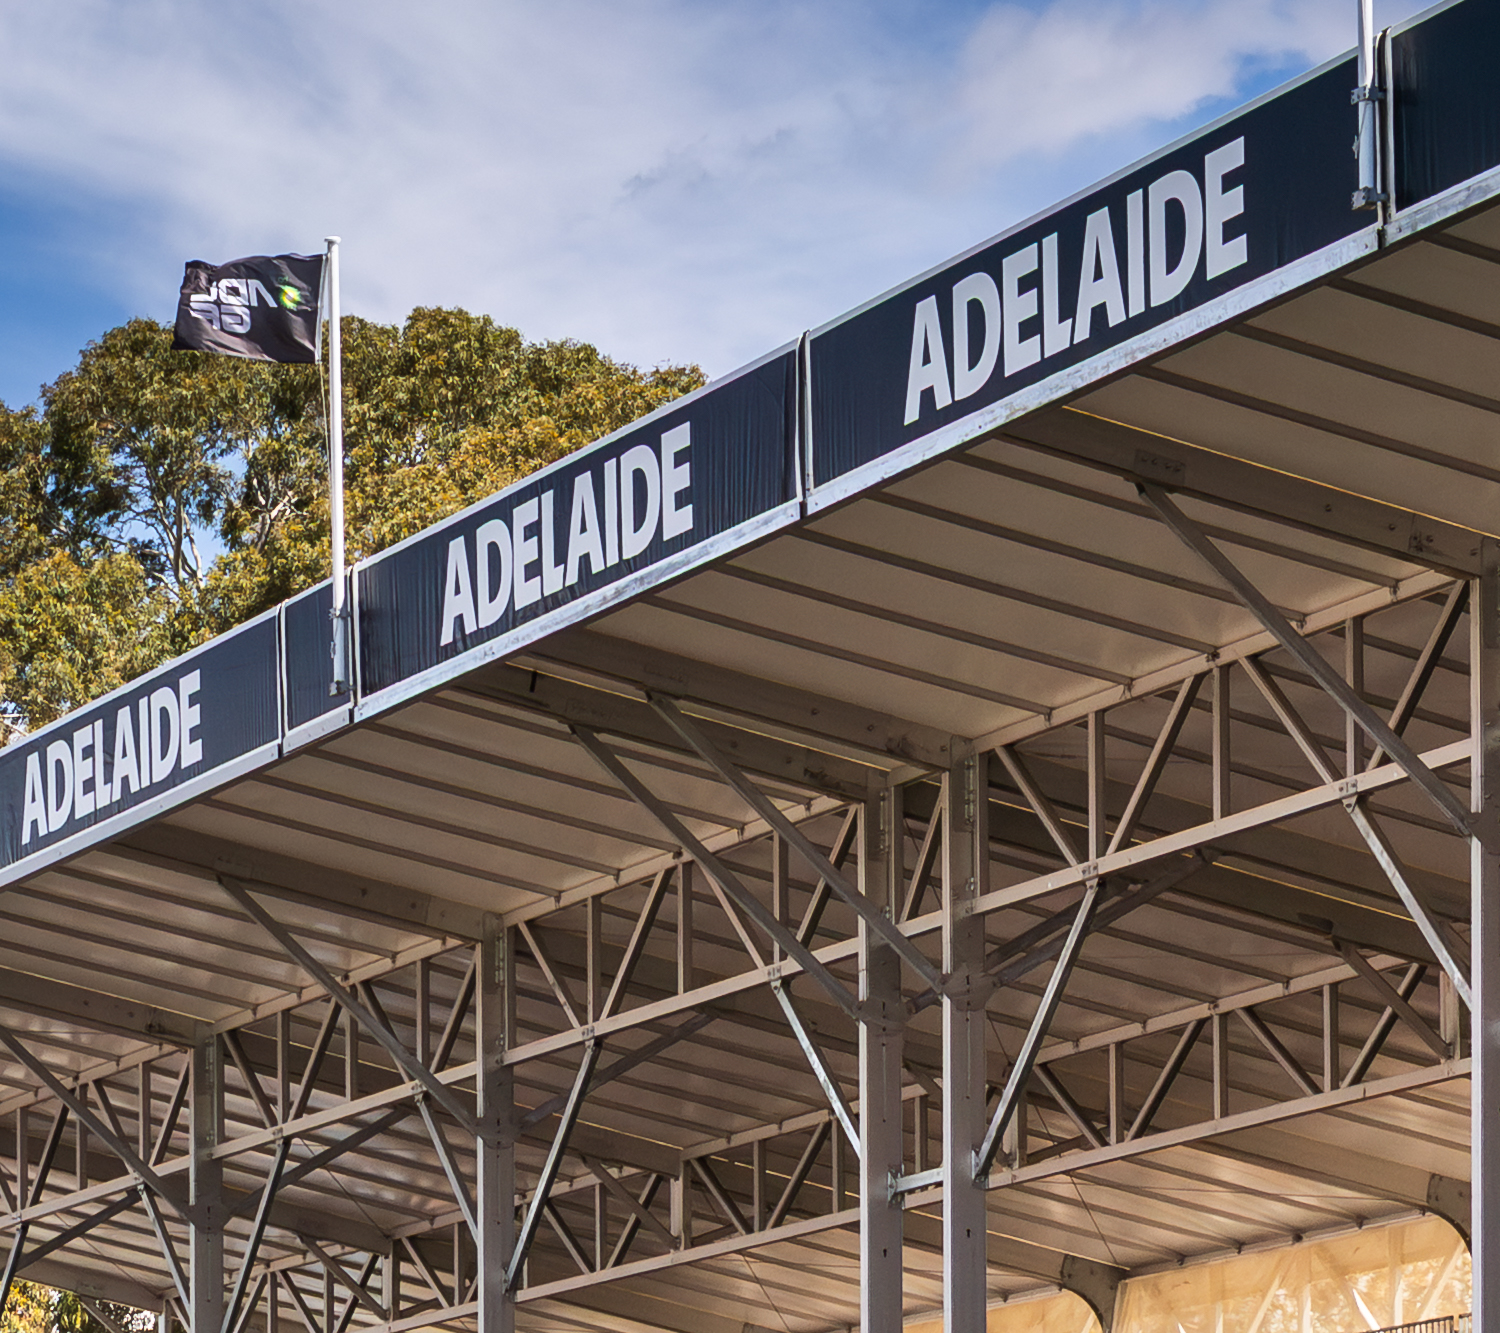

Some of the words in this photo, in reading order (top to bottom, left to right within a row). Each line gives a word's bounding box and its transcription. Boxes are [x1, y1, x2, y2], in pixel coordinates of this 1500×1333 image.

[903, 136, 1250, 426] ADELAIDE
[439, 422, 692, 647] ADELAIDE
[21, 671, 202, 846] ADELAIDE
